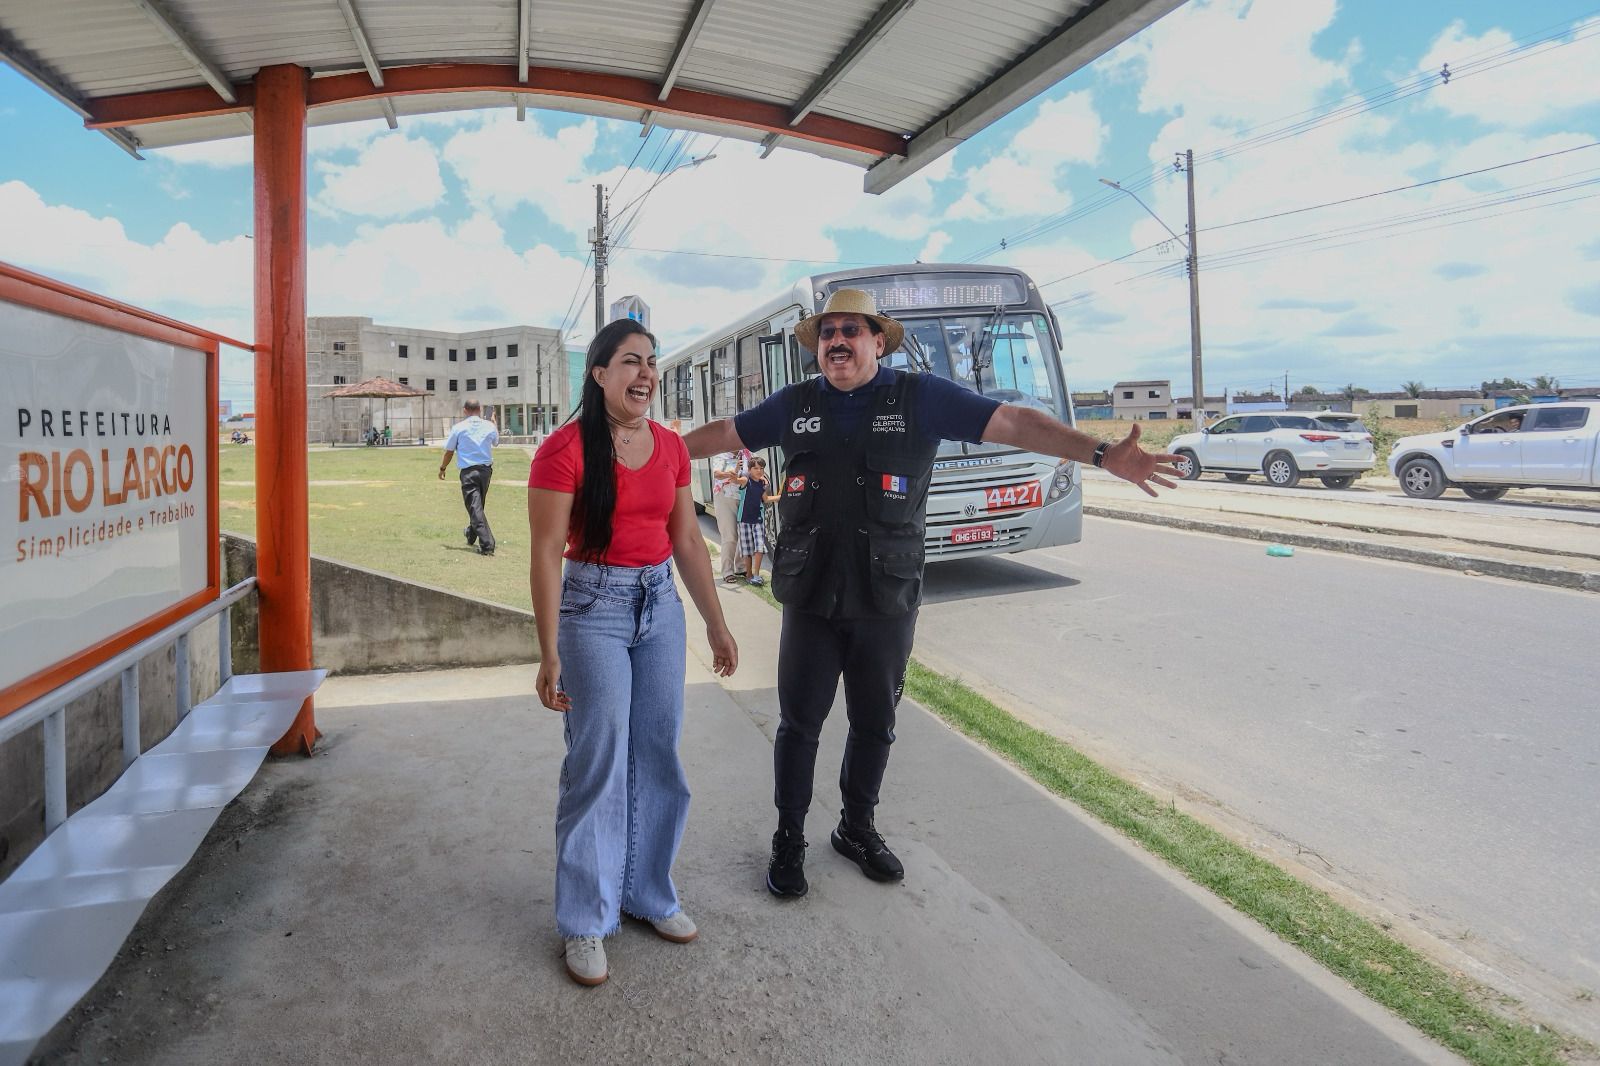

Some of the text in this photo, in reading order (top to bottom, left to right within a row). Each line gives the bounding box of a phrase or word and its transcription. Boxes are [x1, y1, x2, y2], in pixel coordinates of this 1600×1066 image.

[879, 286, 938, 307] JARBAS
[943, 285, 1003, 305] OITICICA
[18, 408, 171, 437] PREFEITURA
[792, 416, 821, 434] GG
[19, 443, 194, 522] RIO LARGO
[988, 482, 1041, 507] 4427
[17, 501, 196, 562] Simplicidade e Trabalho
